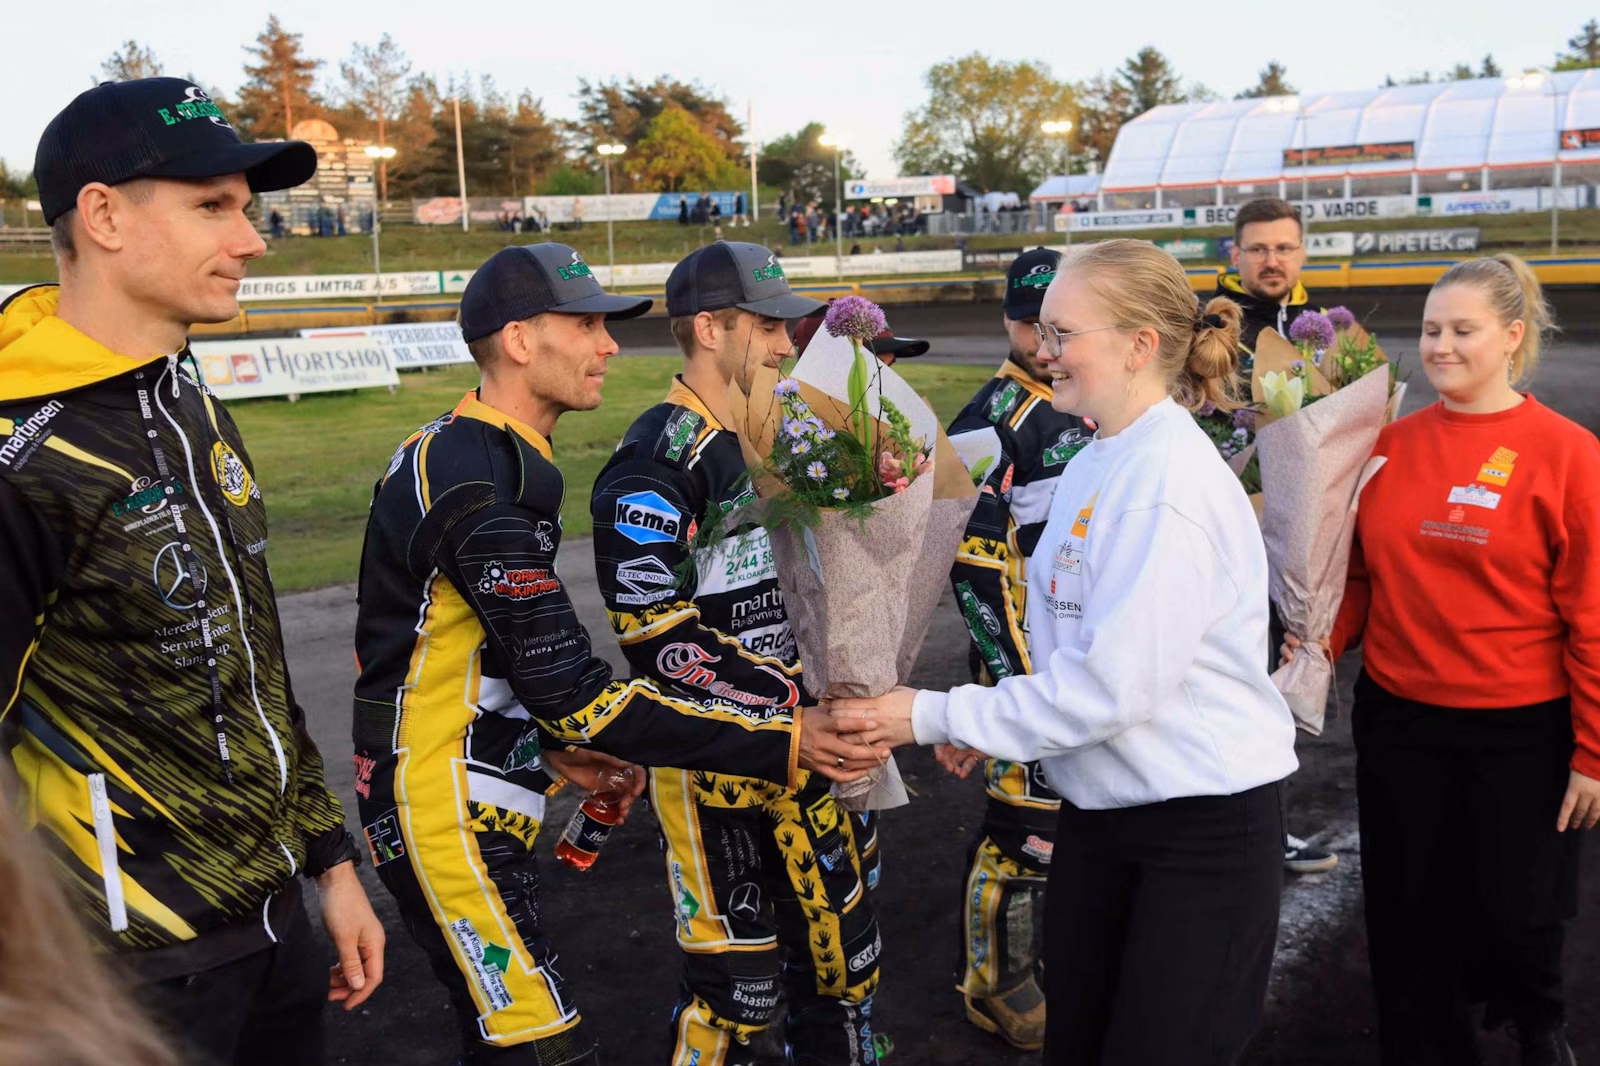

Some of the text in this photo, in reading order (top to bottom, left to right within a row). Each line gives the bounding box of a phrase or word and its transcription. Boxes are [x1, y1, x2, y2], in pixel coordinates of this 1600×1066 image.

[1323, 201, 1377, 217] VARDE
[305, 279, 368, 293] LIMTRÆ
[261, 345, 392, 379] HJORTSHØJ
[137, 390, 153, 419] DISPEED
[0, 399, 64, 466] martinsen
[170, 504, 186, 533] DISPEED
[617, 503, 679, 537] Kema
[201, 618, 213, 648] DISPEED
[525, 645, 553, 657] GRUPA
[709, 680, 778, 707] Transport
[470, 935, 483, 959] Klima
[849, 944, 875, 971] CSK
[735, 980, 773, 993] THOMAS
[742, 1009, 755, 1019] 24
